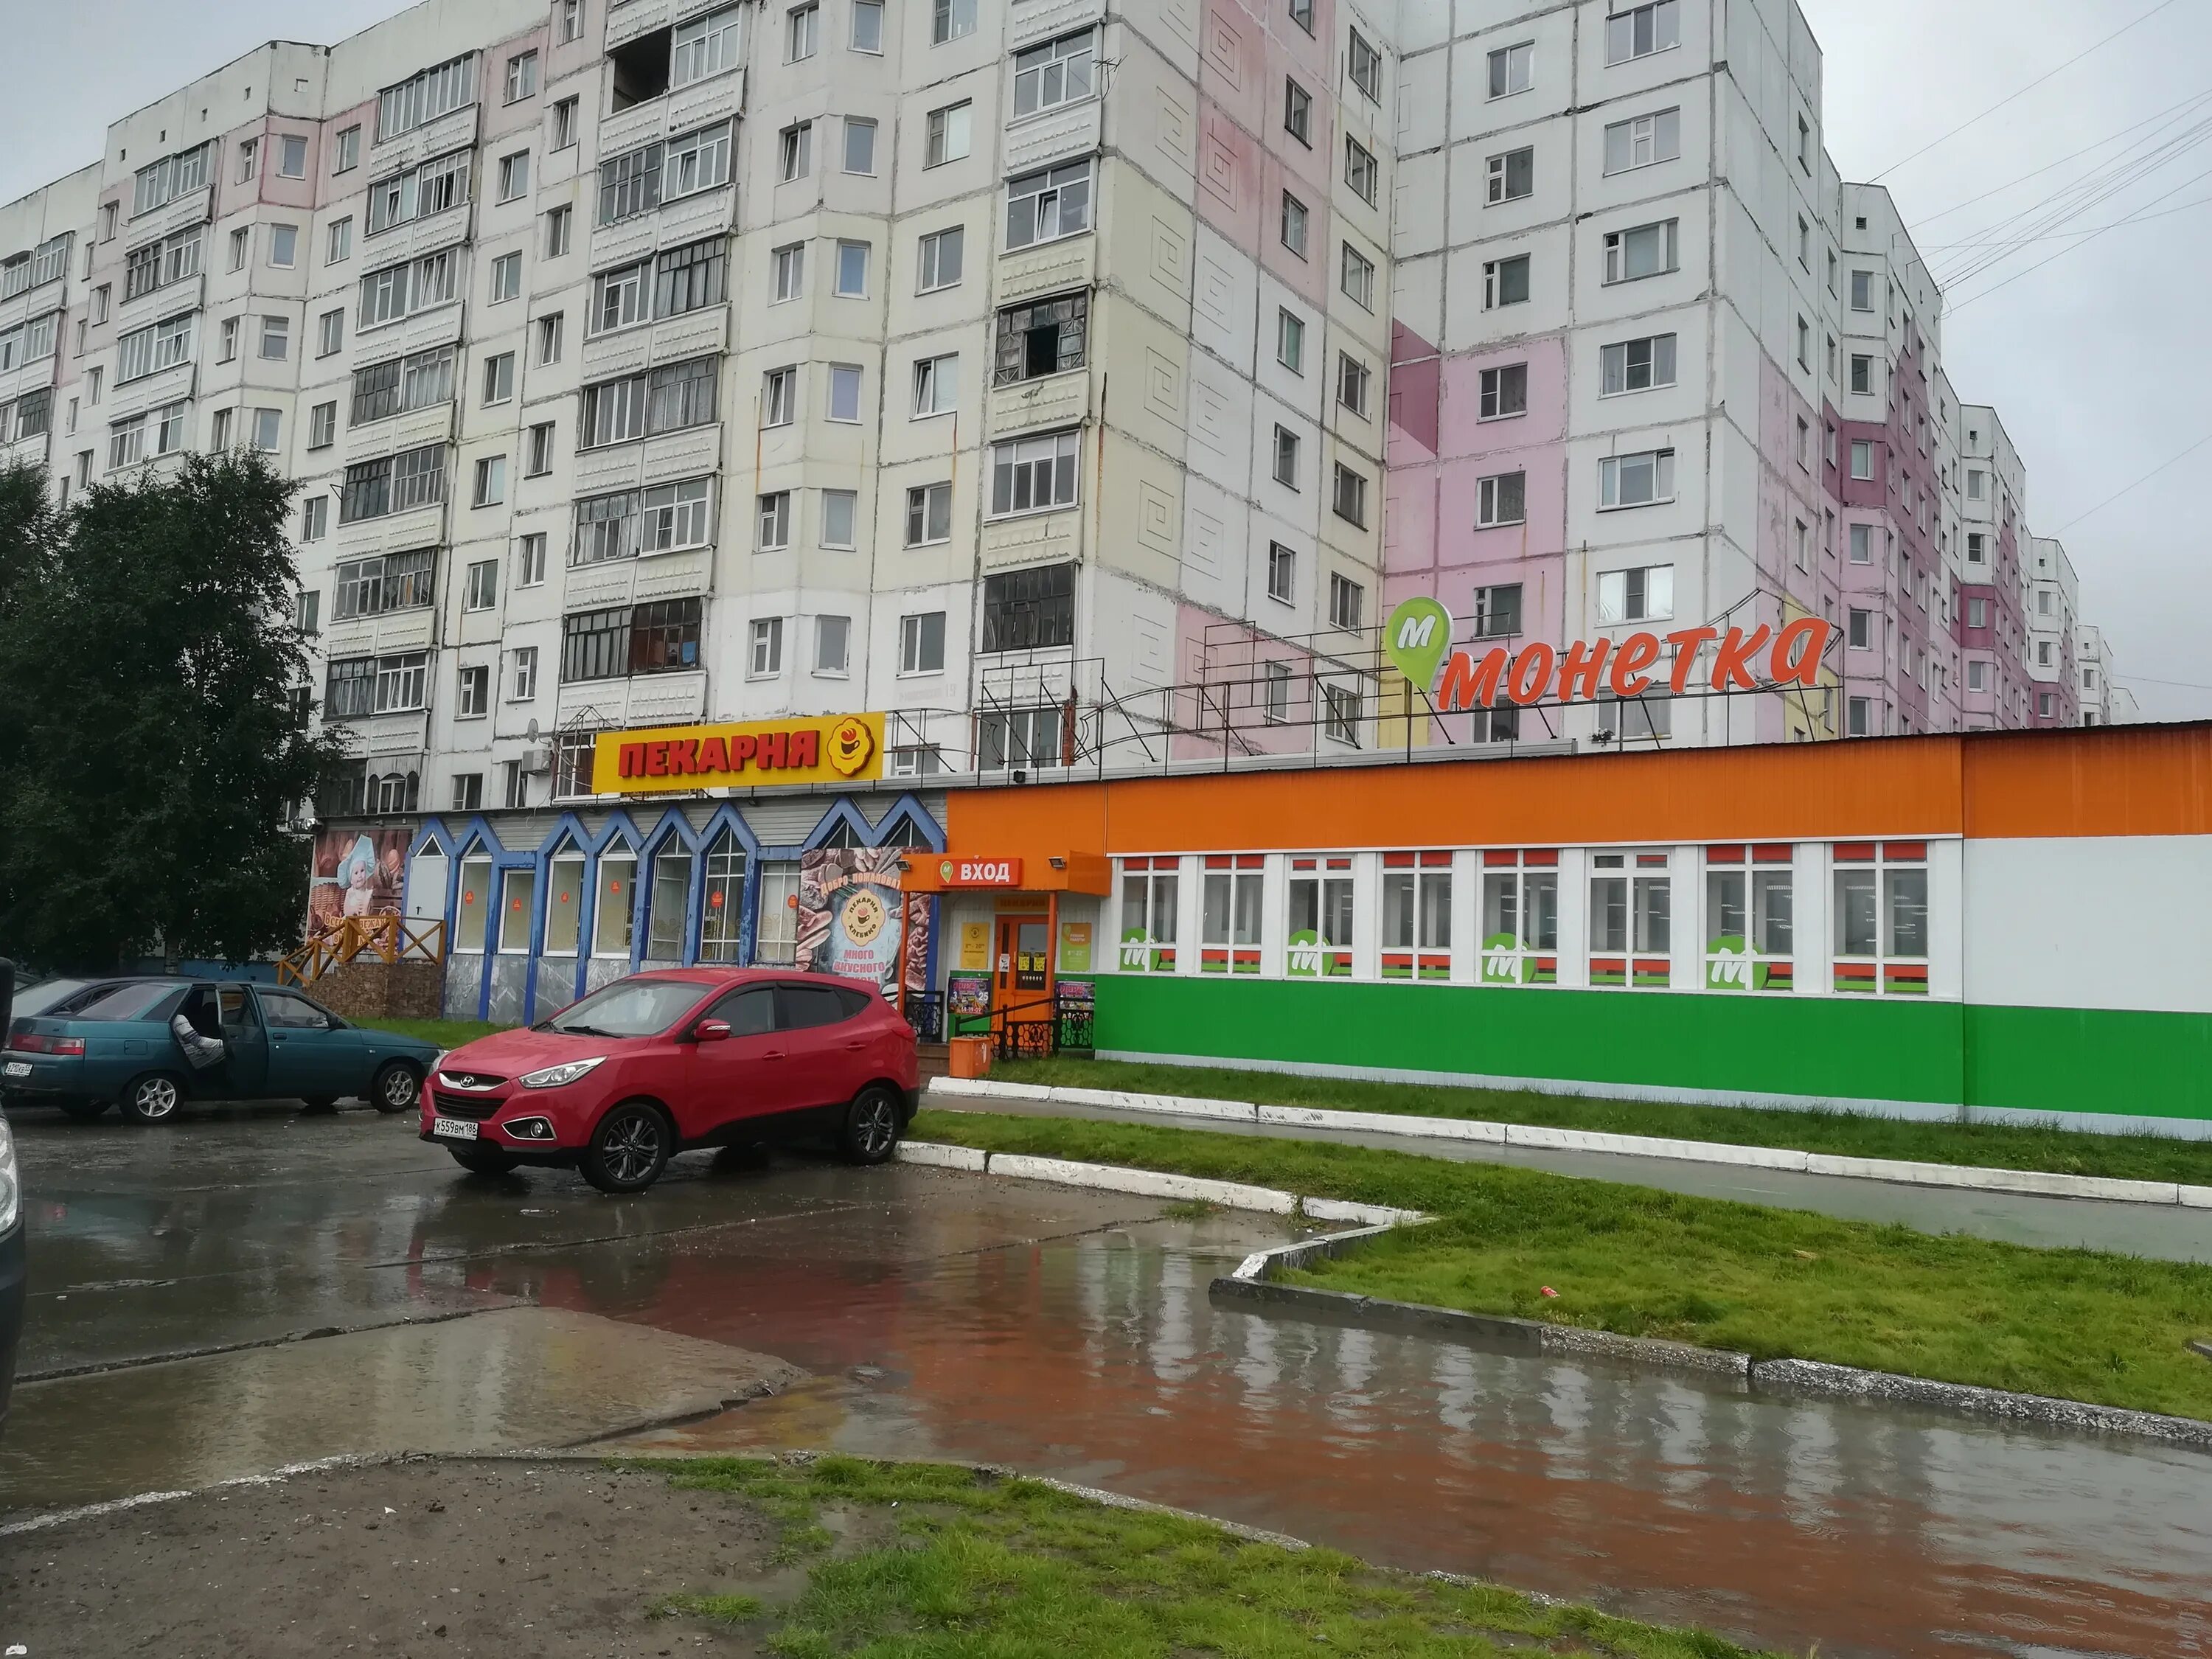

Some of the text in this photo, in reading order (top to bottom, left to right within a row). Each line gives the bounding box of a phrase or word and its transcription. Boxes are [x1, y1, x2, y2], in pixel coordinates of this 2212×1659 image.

[618, 729, 820, 779] ПЕКАРНЯ
[961, 863, 1010, 883] ВХОД
[820, 875, 849, 897] ДОБРО
[849, 897, 878, 914] ПЕКАРНЯ
[844, 950, 874, 959] МНОГО
[833, 961, 886, 973] ВКУСНОГО
[978, 992, 989, 1001] 25
[437, 1120, 476, 1134] К559ВМ 186
